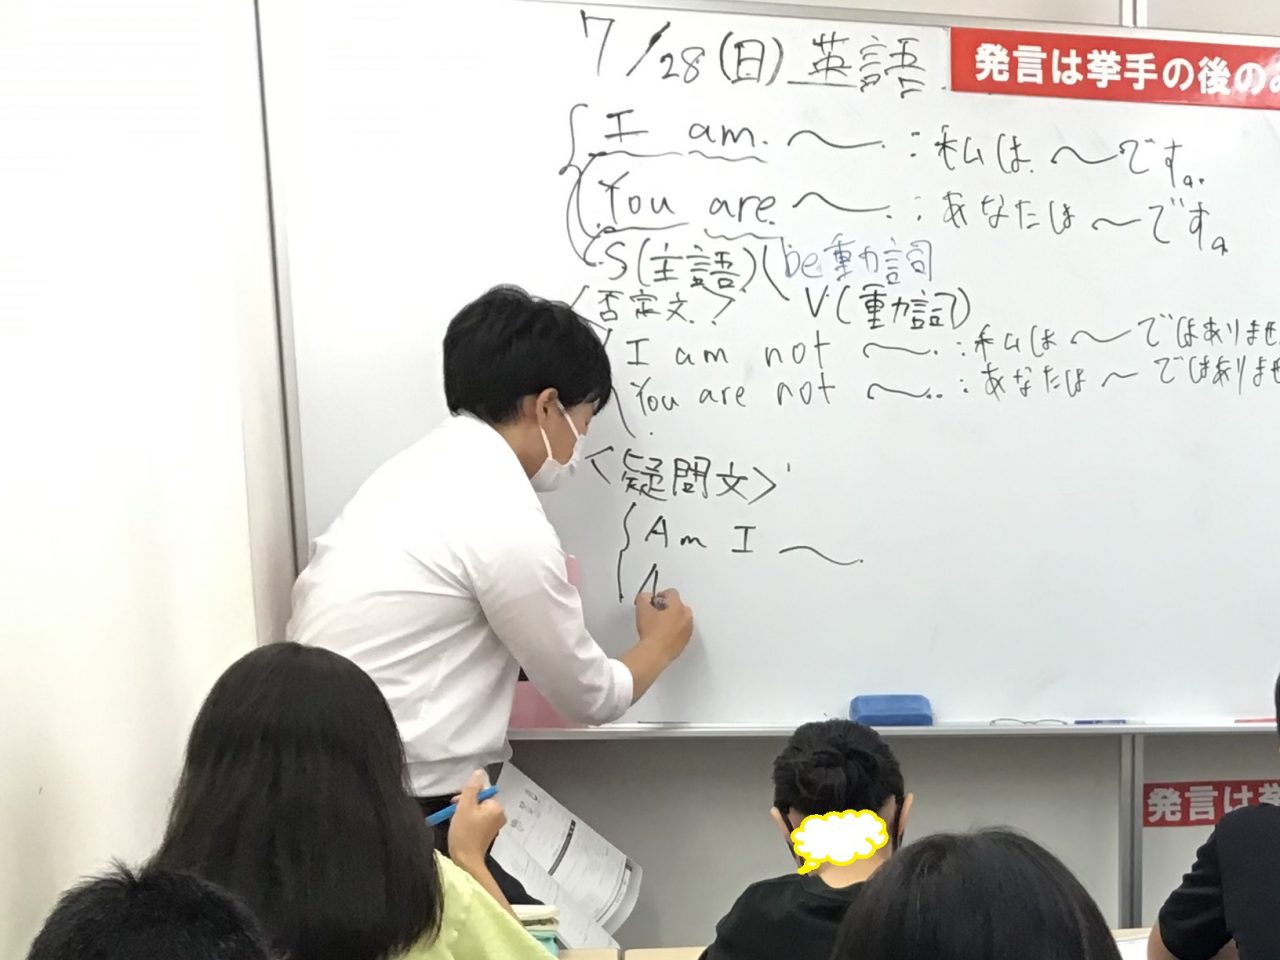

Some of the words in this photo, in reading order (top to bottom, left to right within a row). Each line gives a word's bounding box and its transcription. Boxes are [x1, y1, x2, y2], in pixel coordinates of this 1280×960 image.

[808, 31, 926, 99] 英語
[599, 171, 676, 225] You
[626, 338, 650, 366] I
[675, 348, 729, 366] am
[765, 330, 831, 369] not
[630, 376, 679, 416] You
[699, 385, 747, 407] are
[777, 372, 836, 405] not
[645, 516, 707, 549] Am
[731, 525, 757, 553] I
